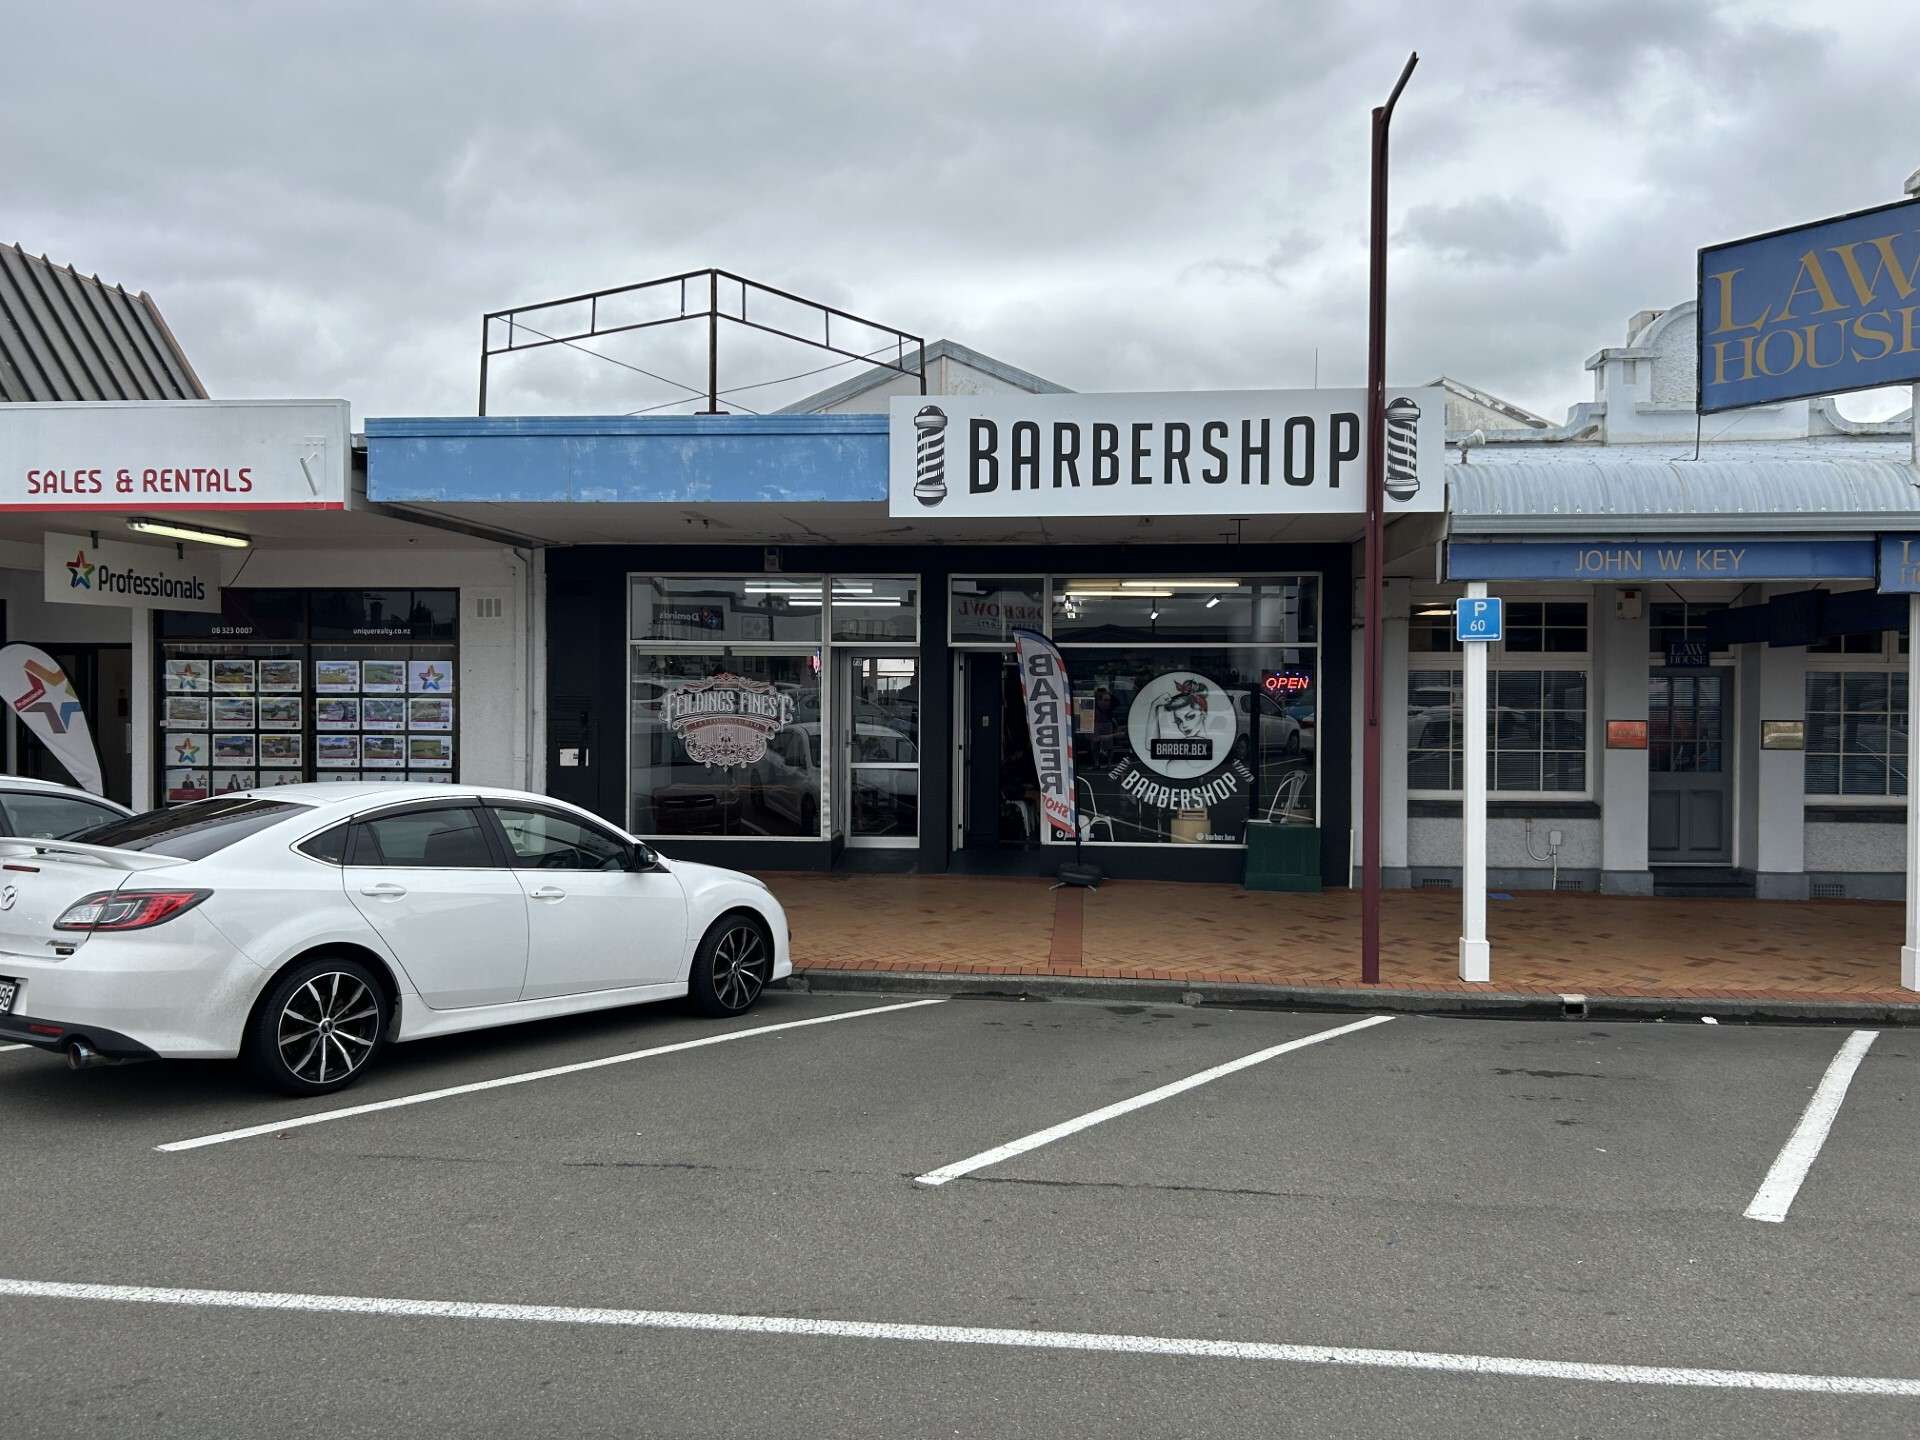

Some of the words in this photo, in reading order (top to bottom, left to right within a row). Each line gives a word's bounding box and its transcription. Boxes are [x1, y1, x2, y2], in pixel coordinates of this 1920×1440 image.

[1708, 229, 1920, 335] LAW
[969, 412, 1360, 494] BARBERSHOP
[27, 470, 102, 494] SALES
[115, 469, 133, 493] &
[143, 468, 253, 493] RENTALS
[1575, 550, 1642, 572] JOHN
[1658, 549, 1687, 571] W.
[1696, 549, 1746, 571] KEY
[98, 565, 205, 601] Professionals
[1474, 601, 1488, 617] P
[1470, 620, 1486, 632] 60
[1670, 655, 1707, 665] HOUSE
[1671, 643, 1706, 655] LAW
[1265, 676, 1309, 689] OPEN
[738, 691, 796, 732] FINEST
[1156, 743, 1207, 756] BARBER.BEX
[1121, 769, 1238, 811] BARBERSHOP
